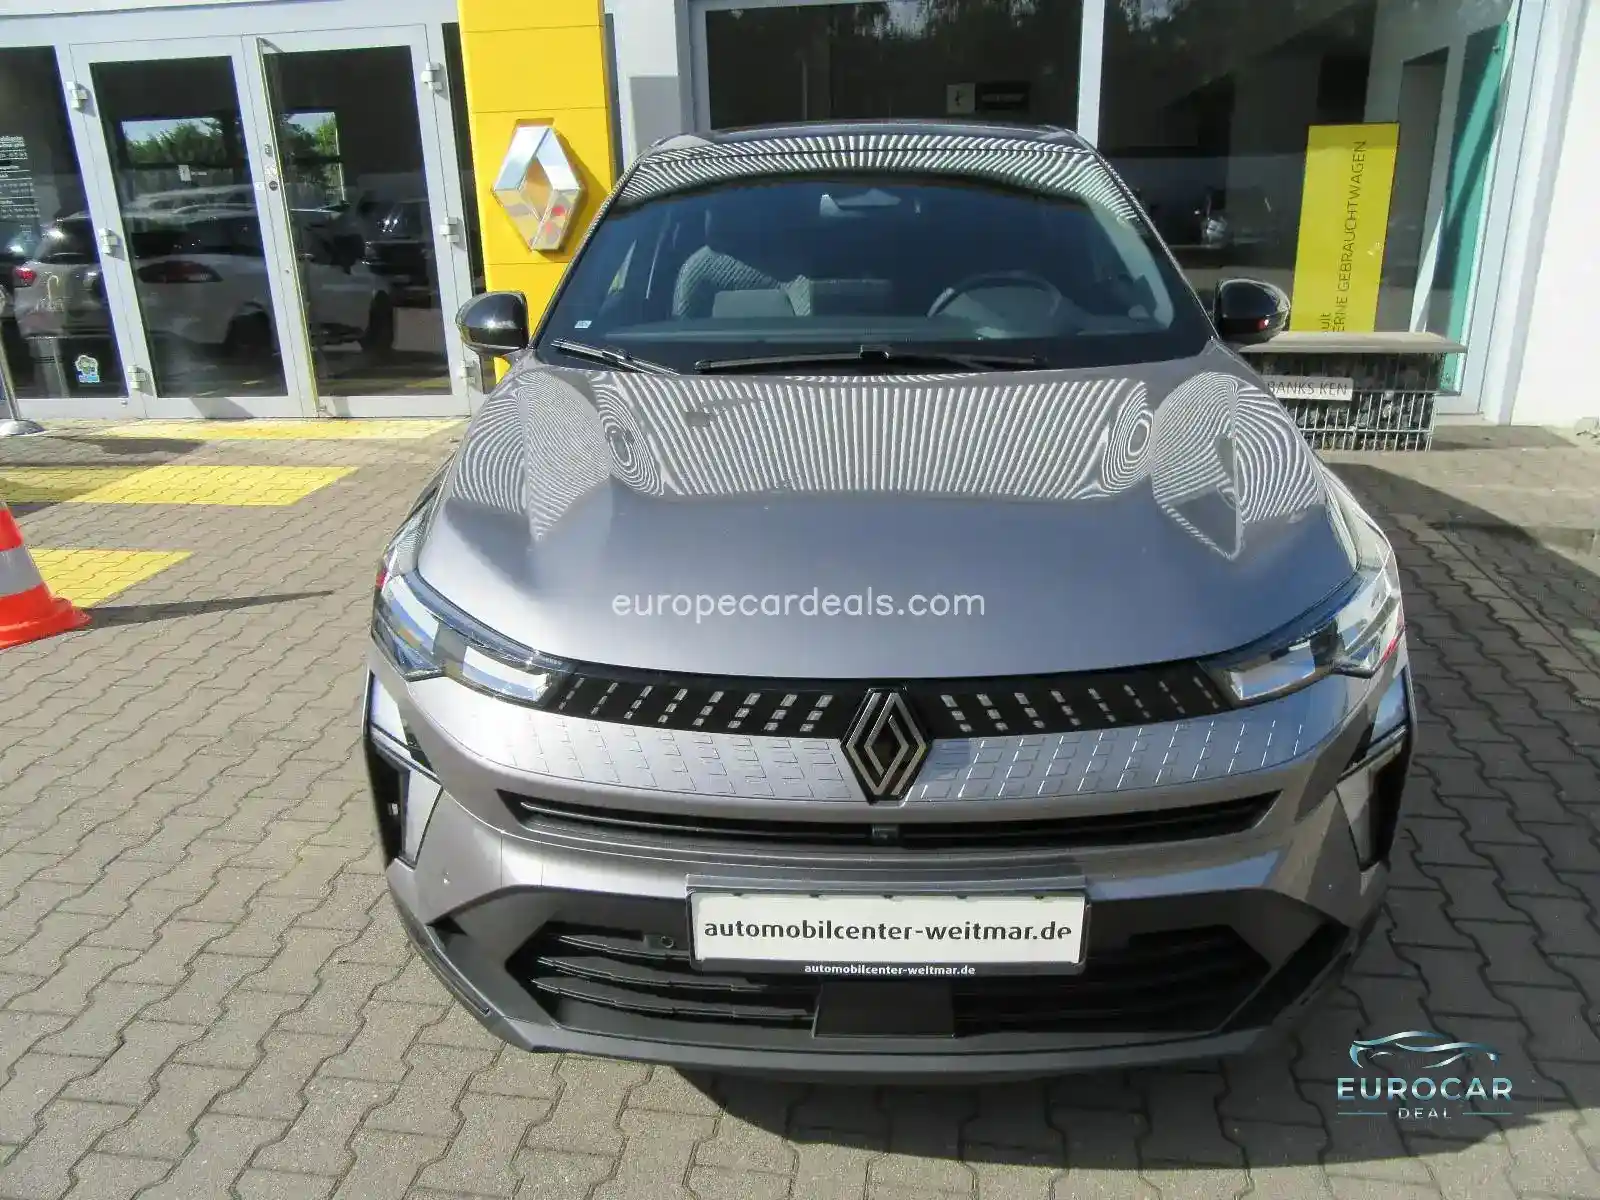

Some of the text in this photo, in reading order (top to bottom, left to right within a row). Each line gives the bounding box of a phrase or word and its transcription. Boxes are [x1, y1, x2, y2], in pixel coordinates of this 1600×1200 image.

[1338, 140, 1367, 292] GEBRAUCHTWAGEN
[704, 920, 1072, 941] automobilcenter-weitmar.de
[804, 963, 976, 976] automobilcenter-weitmar.de
